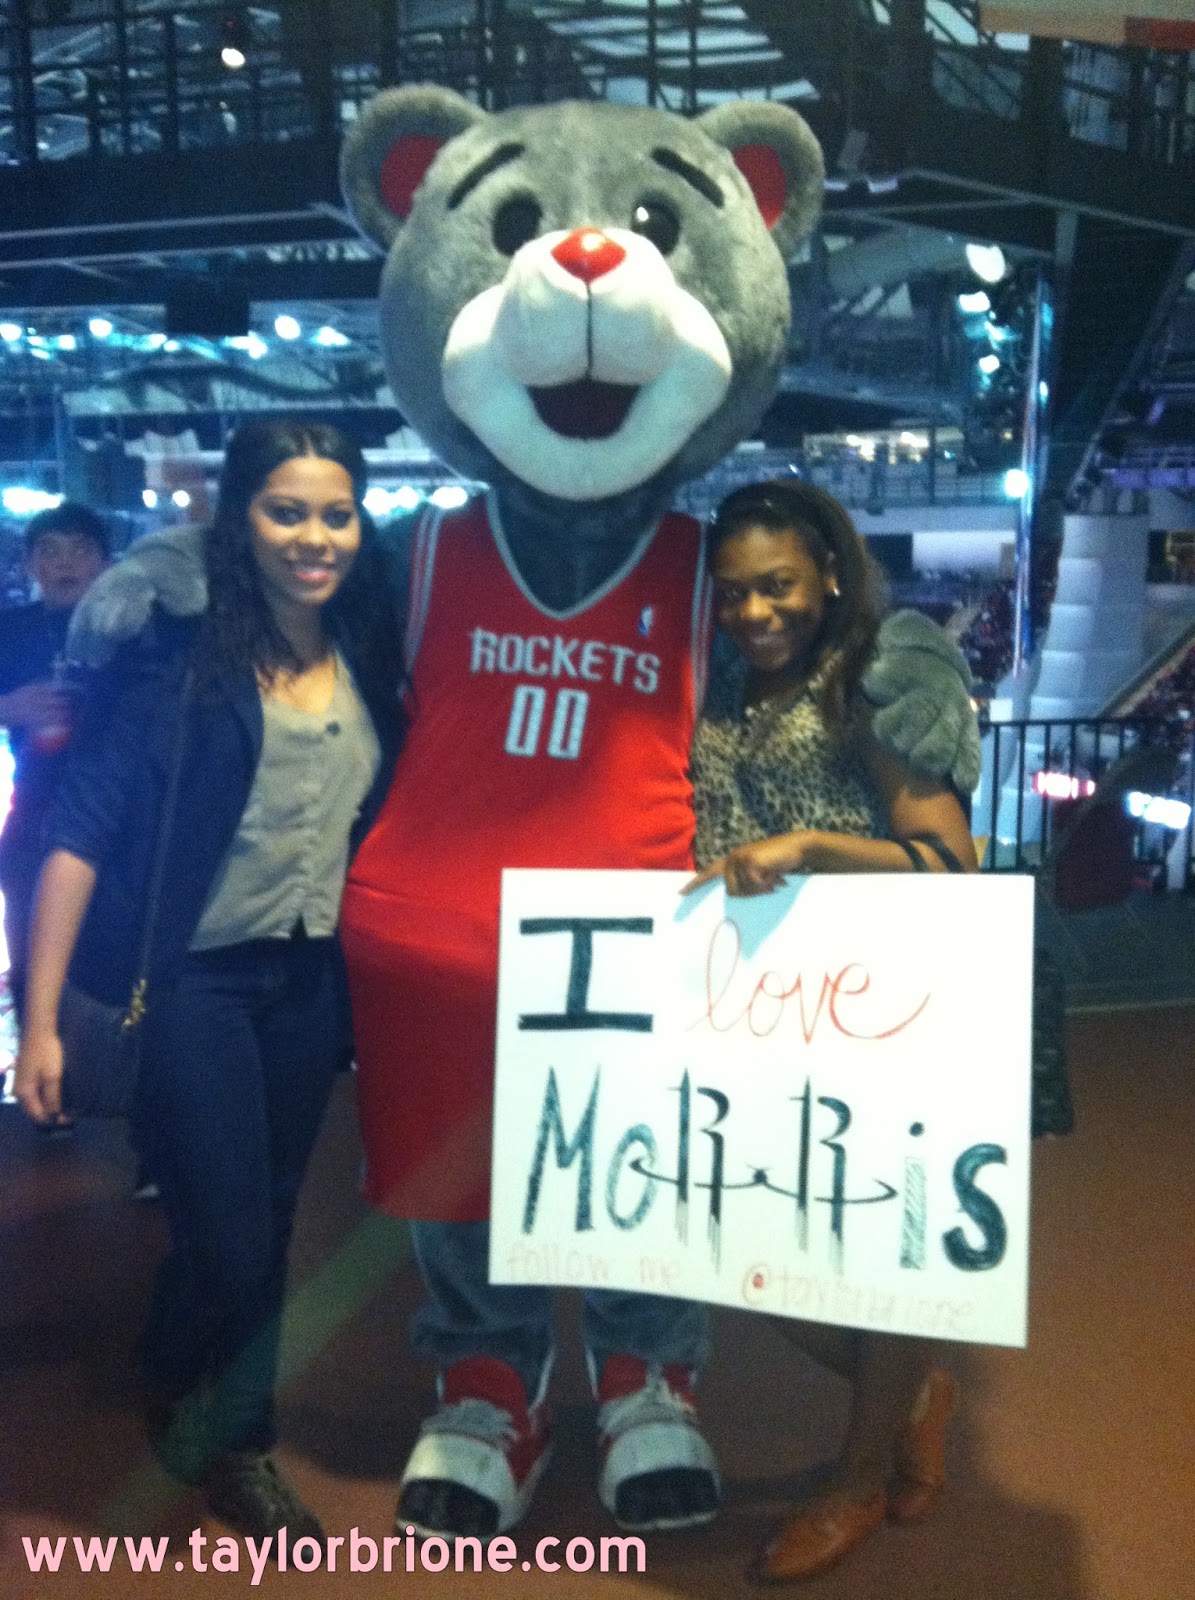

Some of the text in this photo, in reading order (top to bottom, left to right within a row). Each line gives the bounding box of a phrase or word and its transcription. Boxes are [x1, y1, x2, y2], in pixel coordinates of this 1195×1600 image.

[470, 626, 661, 695] ROCKETS
[504, 684, 590, 760] 00
[517, 916, 931, 1045] I love
